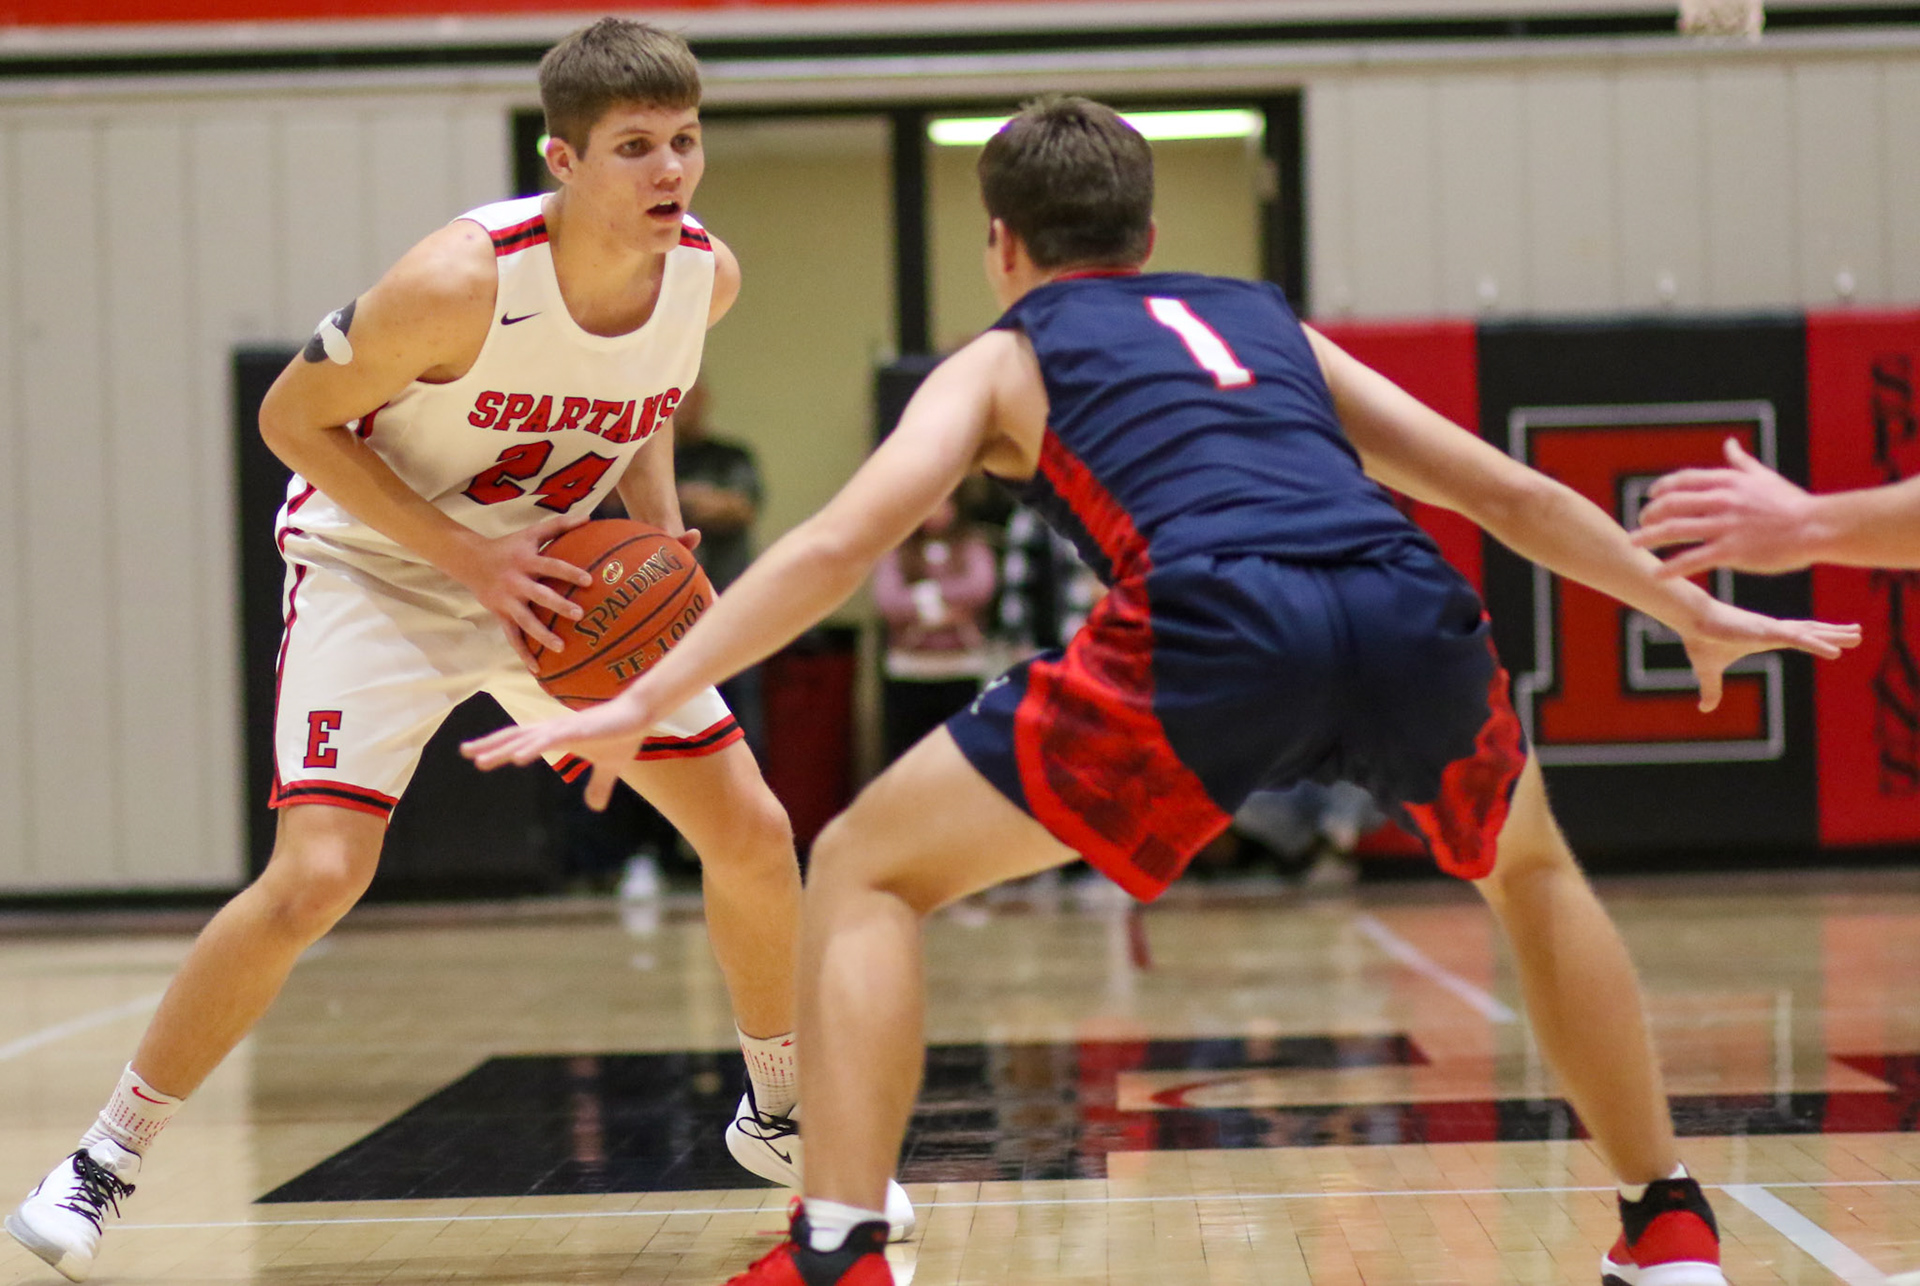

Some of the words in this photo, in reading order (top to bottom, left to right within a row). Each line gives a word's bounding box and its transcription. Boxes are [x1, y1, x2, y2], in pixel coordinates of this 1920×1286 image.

[1145, 296, 1255, 390] 1
[467, 387, 683, 444] SPARTANS
[460, 439, 619, 514] 24
[574, 545, 684, 648] SPALDING
[1508, 400, 1785, 766] E
[606, 593, 706, 681] TF-1000
[303, 710, 343, 769] E
